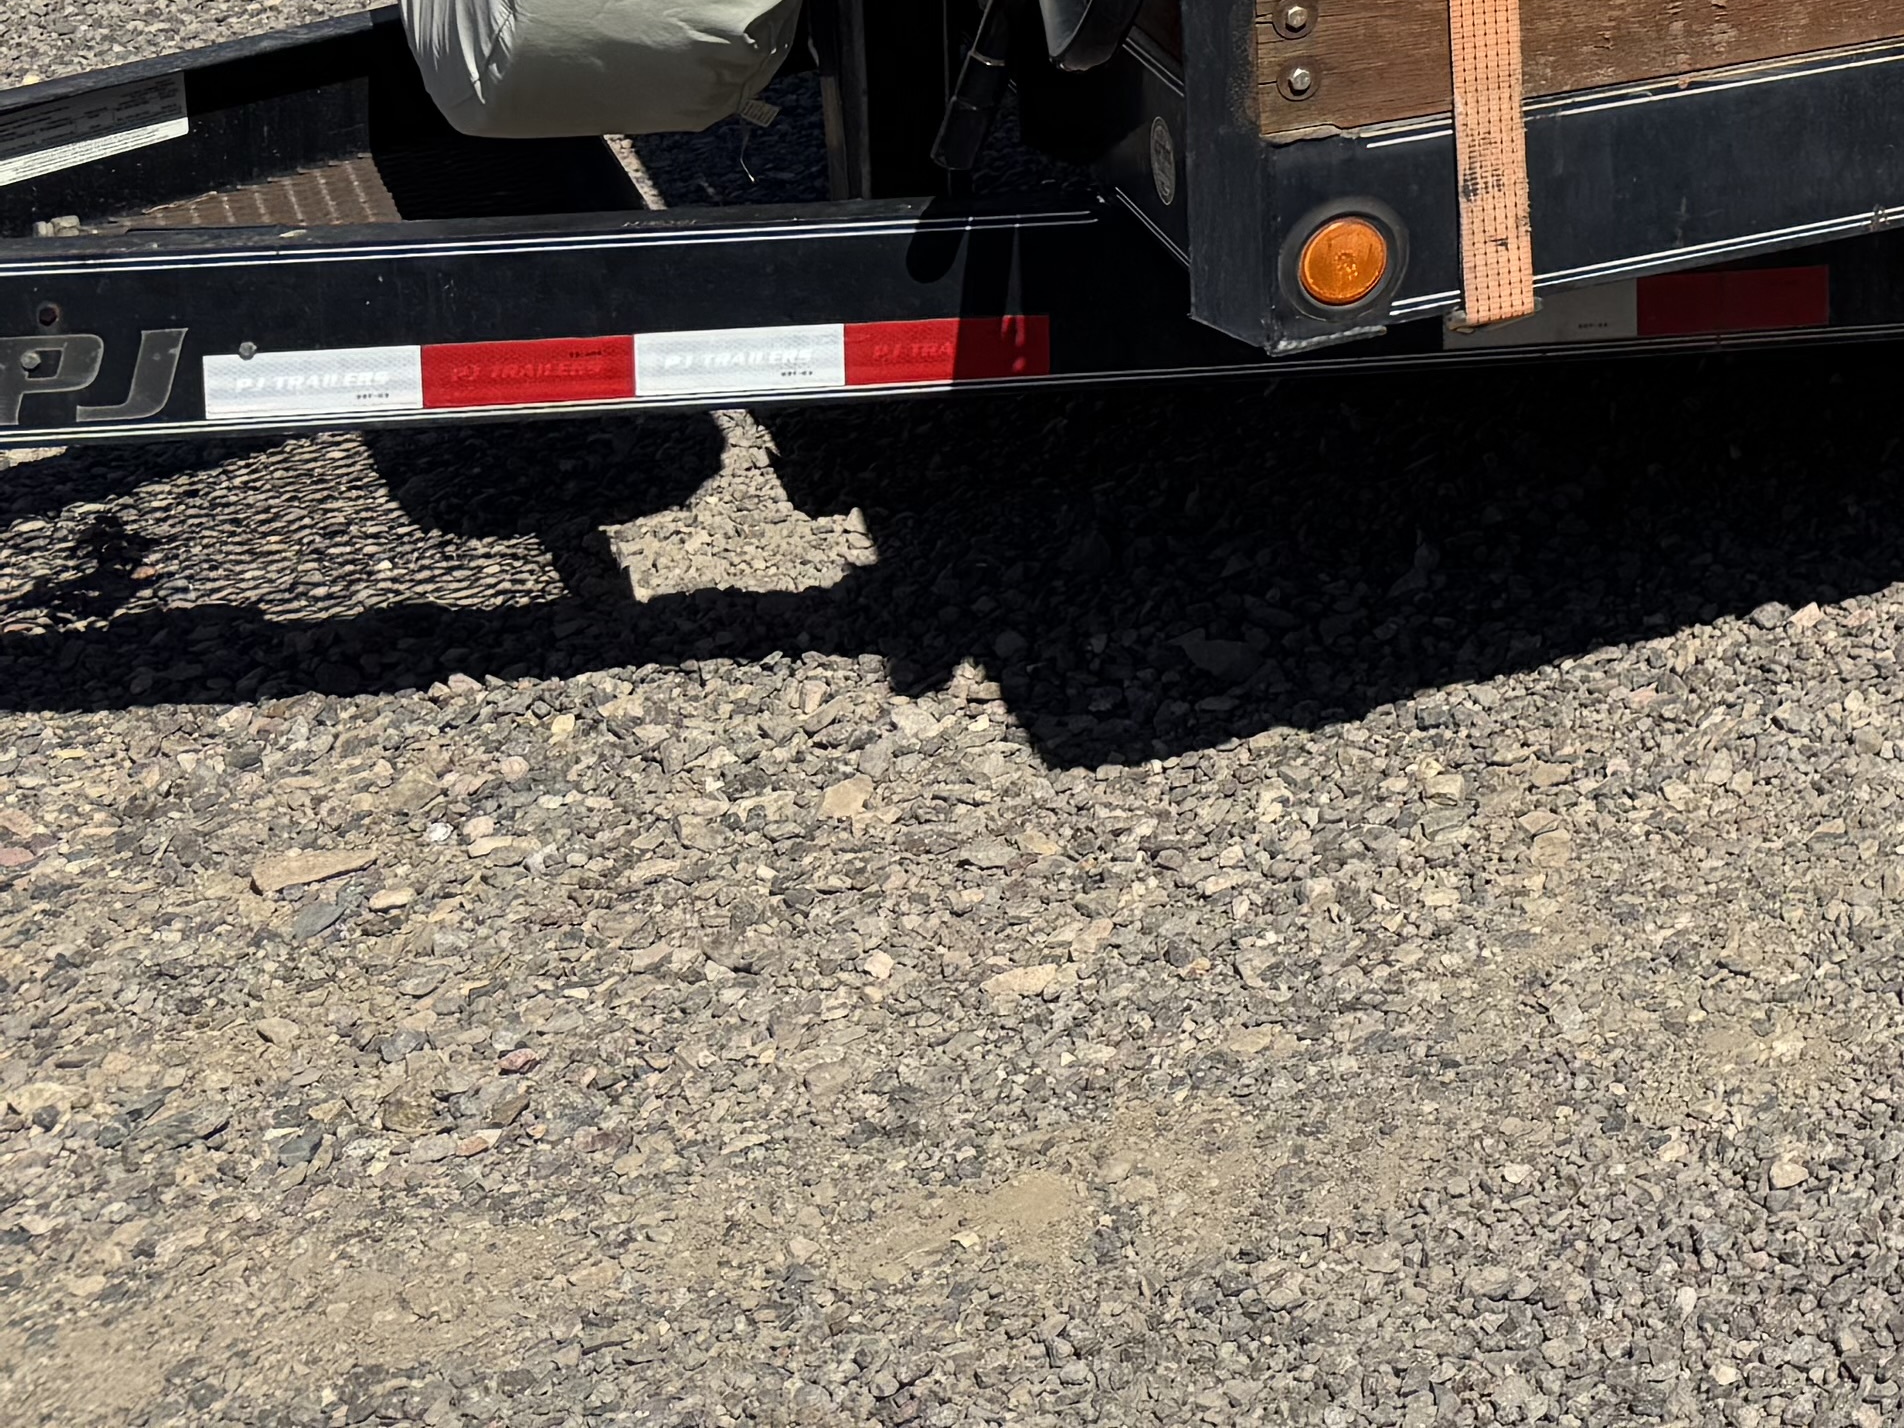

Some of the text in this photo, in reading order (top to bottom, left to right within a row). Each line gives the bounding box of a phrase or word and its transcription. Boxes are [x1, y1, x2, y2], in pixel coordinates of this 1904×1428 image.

[664, 348, 813, 369] PJ TRAILERS
[0, 327, 188, 425] PJ
[235, 370, 391, 393] PJ TRAILERS
